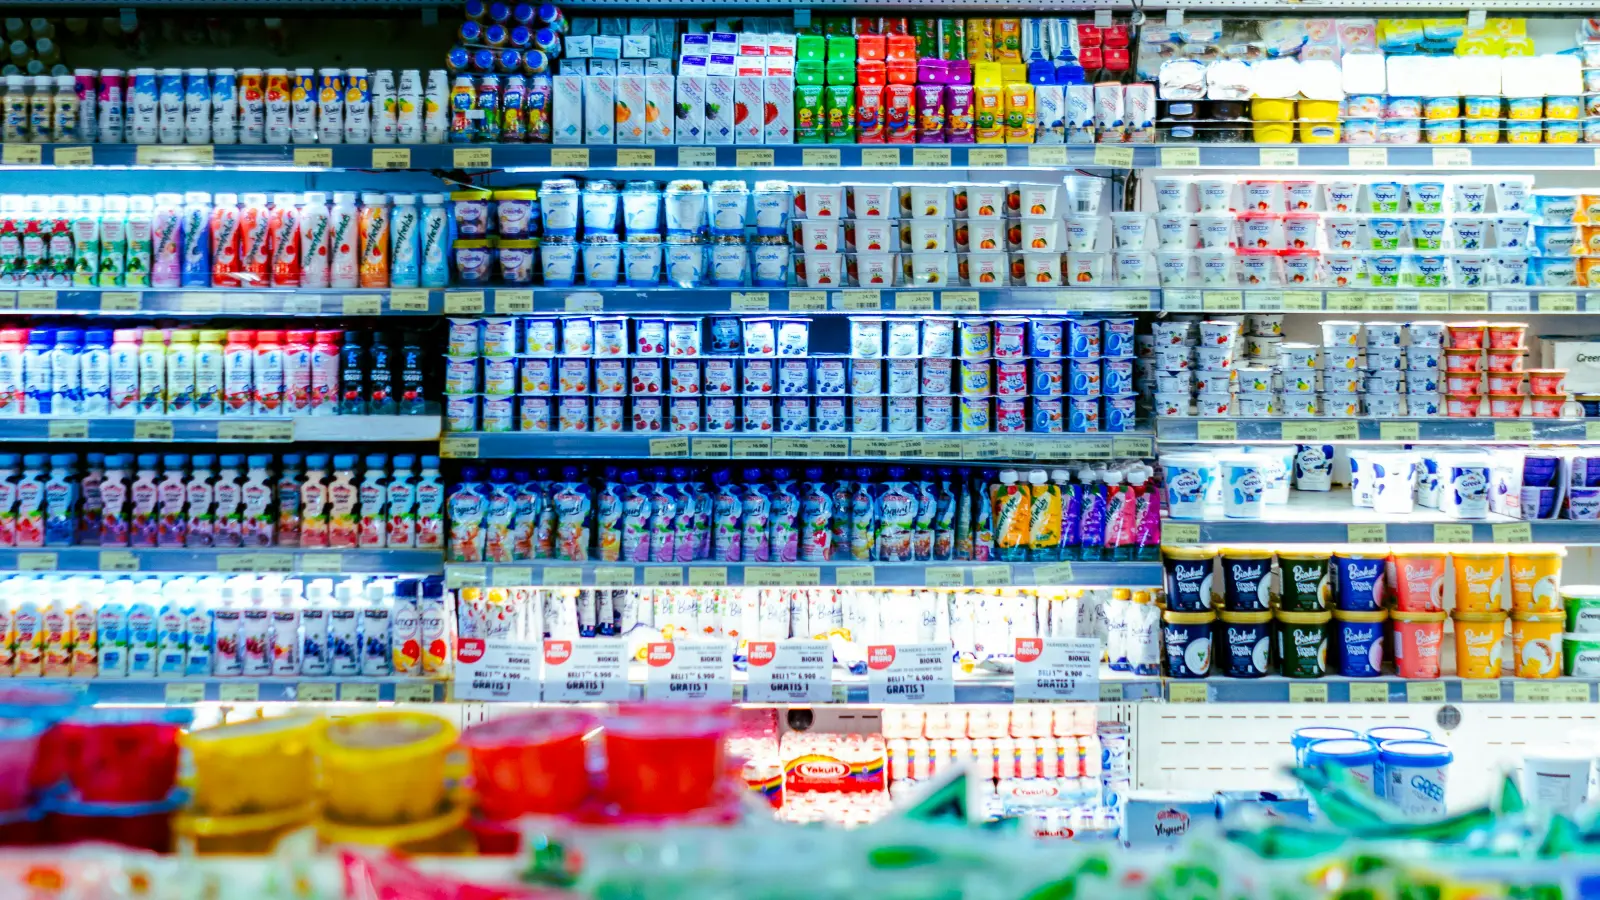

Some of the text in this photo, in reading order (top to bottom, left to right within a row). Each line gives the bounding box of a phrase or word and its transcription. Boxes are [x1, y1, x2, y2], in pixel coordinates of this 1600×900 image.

[1332, 192, 1352, 202] Yoghurt
[1374, 192, 1396, 201] Yoghurt
[1418, 192, 1440, 201] Yoghurt
[1462, 192, 1484, 201] Yoghurt
[1336, 228, 1356, 238] Yoghurt
[1375, 228, 1397, 238] Yoghurt
[1422, 228, 1442, 238] Yoghurt
[1459, 229, 1480, 238] Yoghurt
[1331, 265, 1352, 274] Yoghurt
[1374, 265, 1396, 274] Yoghurt
[1419, 265, 1440, 274] Yoghurt
[1461, 265, 1482, 274] Yoghurt
[1178, 478, 1197, 486] Greek
[1176, 565, 1204, 580] Biokul
[1233, 565, 1261, 580] Biokul
[1294, 565, 1322, 580] Biokul
[1348, 564, 1377, 579] Biokul
[1228, 628, 1256, 643] Biokul
[1294, 630, 1322, 644] Biokul
[1344, 628, 1373, 642] Biokul
[508, 657, 530, 665] BIOKUL
[472, 682, 505, 690] GRATIS
[566, 681, 599, 689] GRATIS
[670, 683, 701, 691] GRATIS
[771, 683, 802, 691] GRATIS
[1037, 680, 1068, 688] GRATIS
[886, 685, 918, 694] GRATIS
[1155, 819, 1190, 836] Yogurt!
